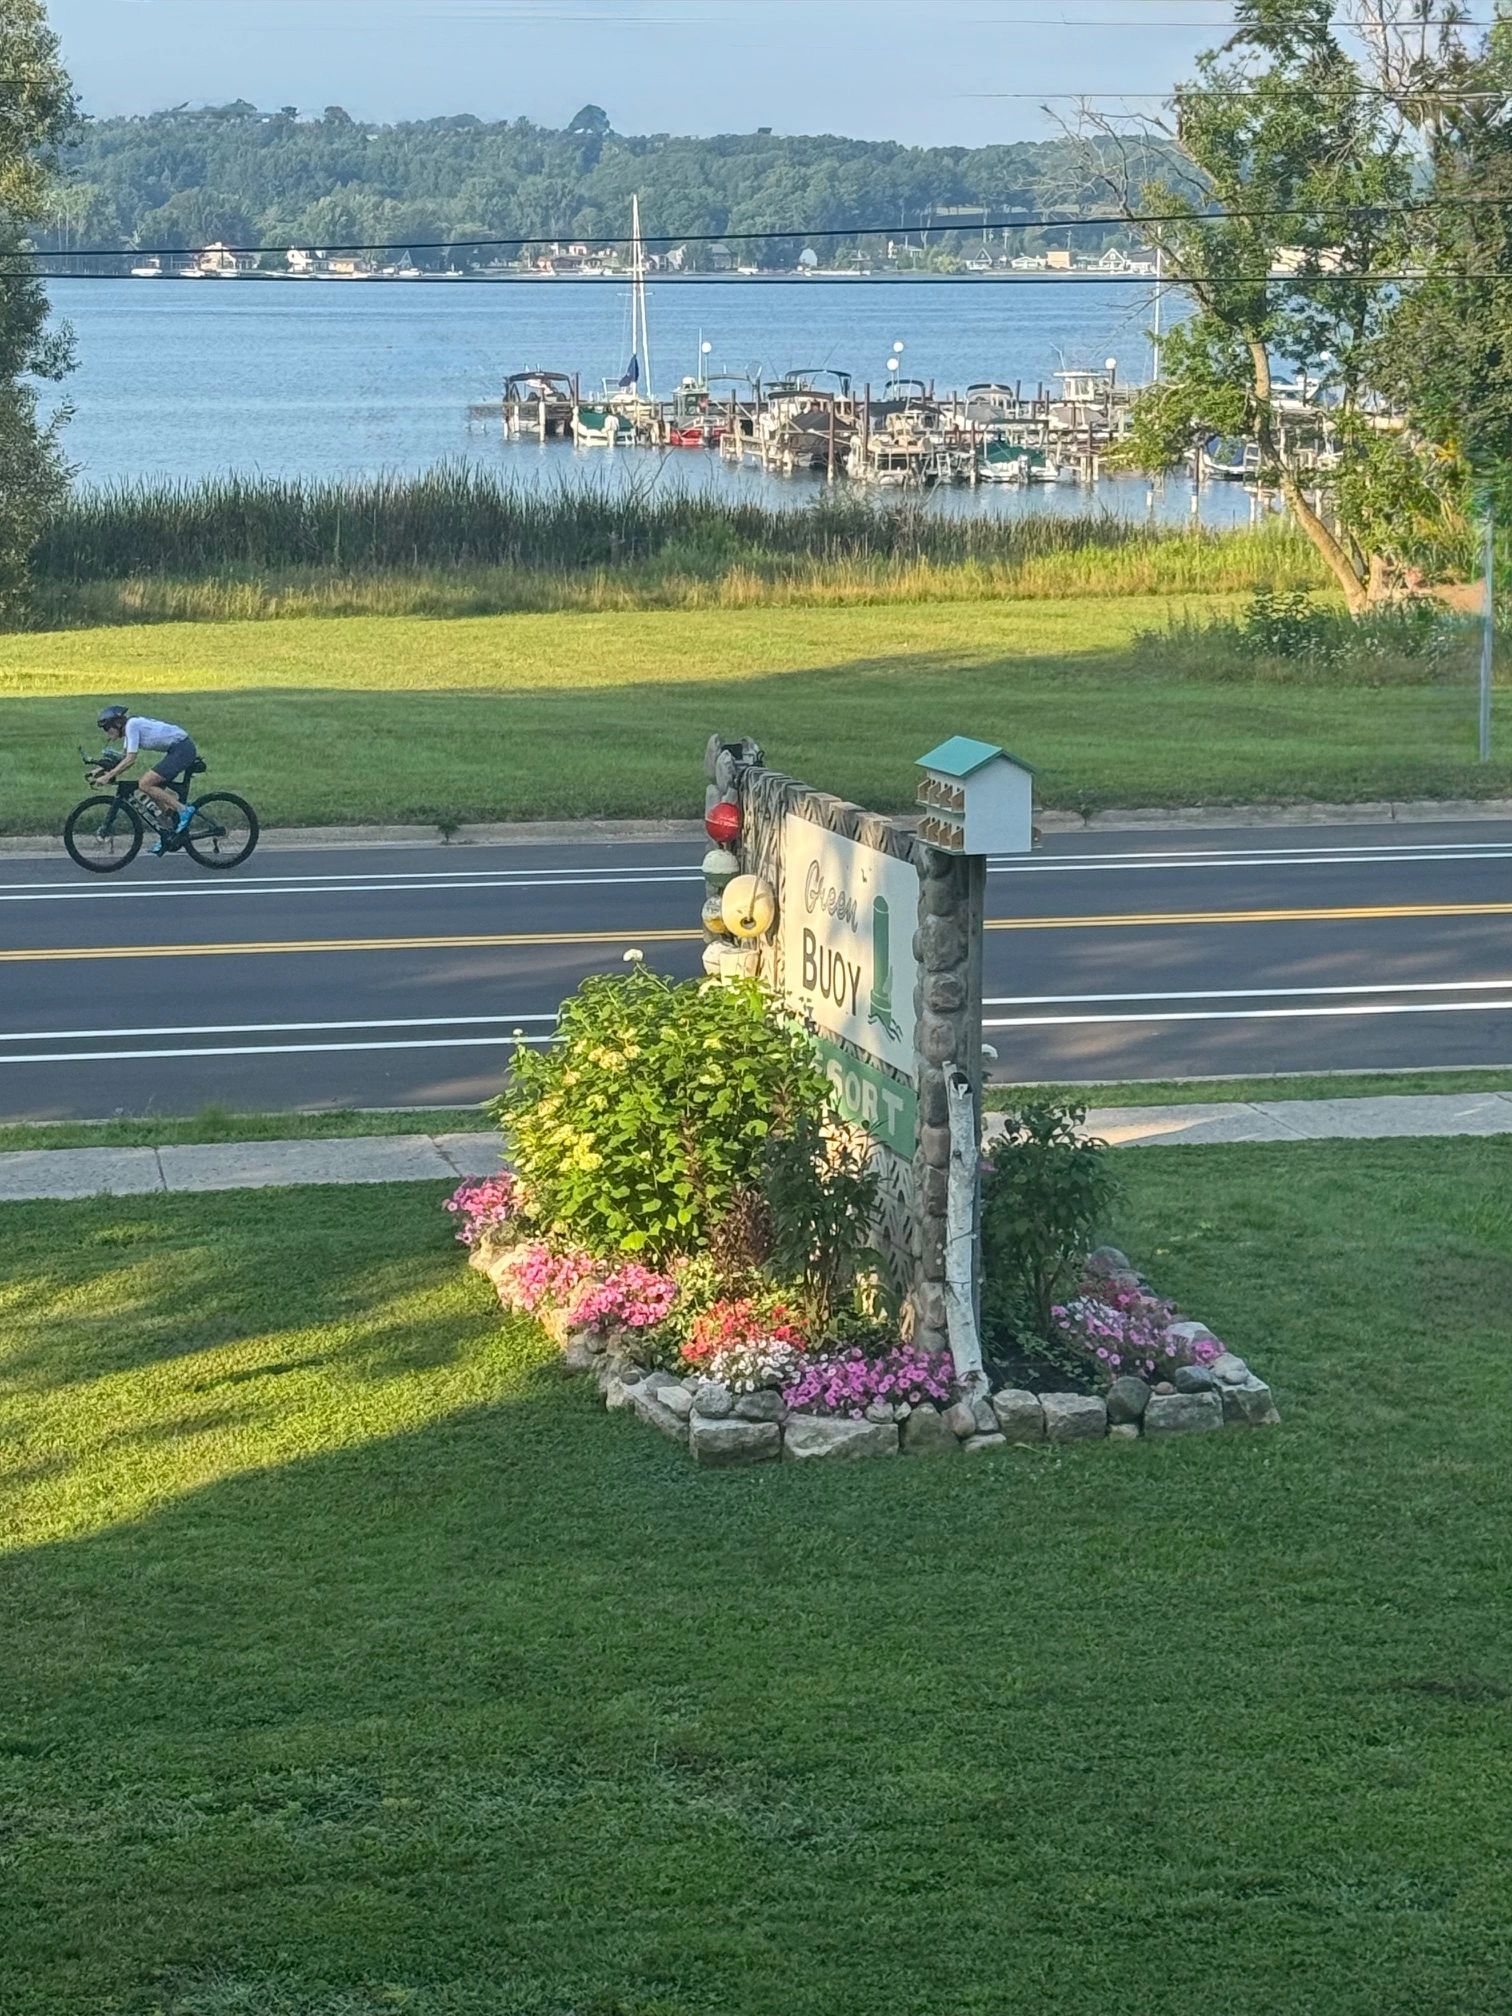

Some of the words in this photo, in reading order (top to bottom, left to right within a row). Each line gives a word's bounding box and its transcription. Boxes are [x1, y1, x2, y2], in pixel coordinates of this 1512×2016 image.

[804, 859, 859, 933] Green
[802, 927, 861, 1017] BUOY
[811, 1052, 904, 1137] SORT
